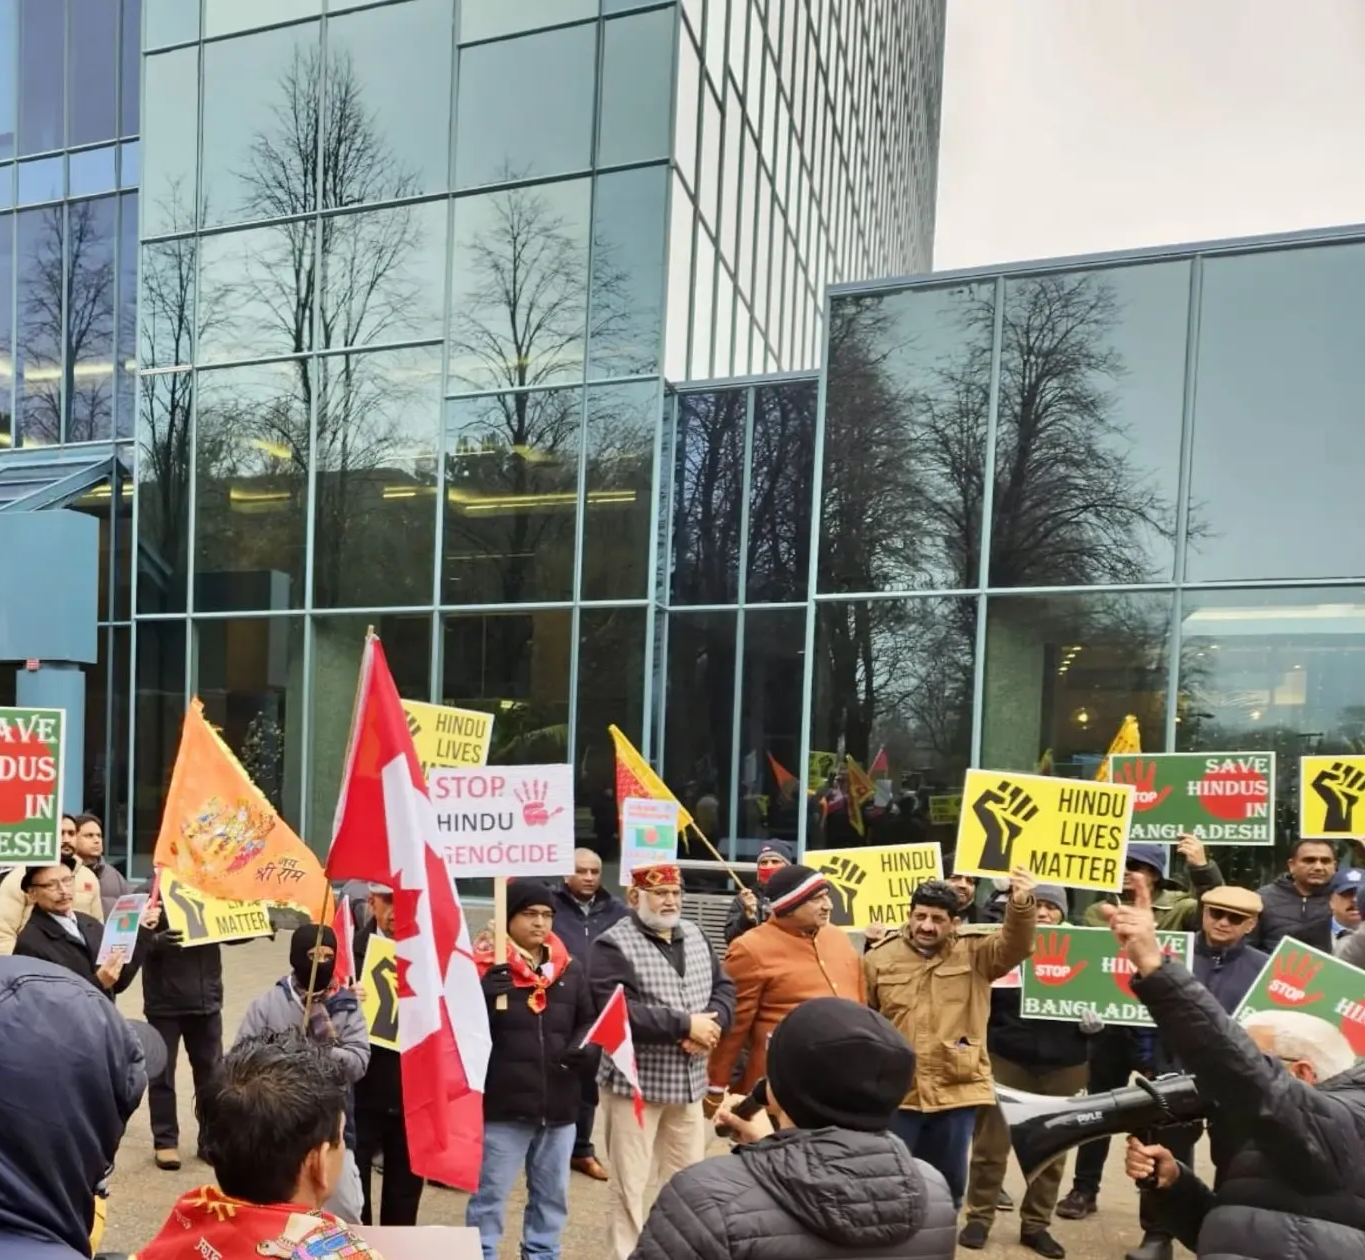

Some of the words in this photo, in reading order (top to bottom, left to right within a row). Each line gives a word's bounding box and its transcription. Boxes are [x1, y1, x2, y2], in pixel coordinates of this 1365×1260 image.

[435, 713, 486, 738] HINDU
[436, 738, 482, 764] LIVES
[1205, 757, 1269, 774] SAVE
[436, 776, 506, 799] STOP
[1133, 791, 1157, 803] TOP
[1187, 780, 1269, 796] HINDUS
[25, 794, 53, 819] IN
[1058, 788, 1126, 817] HINDU
[1245, 803, 1267, 818] IN
[437, 812, 514, 833] HINDU
[1130, 824, 1267, 840] ANGLADESH
[1060, 821, 1121, 850] LIVES
[881, 851, 935, 873] HINDU
[1030, 850, 1117, 884] MATTER
[215, 911, 269, 935] MATTER
[869, 903, 911, 925] MATT
[1035, 964, 1070, 978] STOP
[1268, 979, 1306, 1001] STOP
[1024, 998, 1153, 1020] BANGLADE
[1076, 1111, 1103, 1123] PYLE
